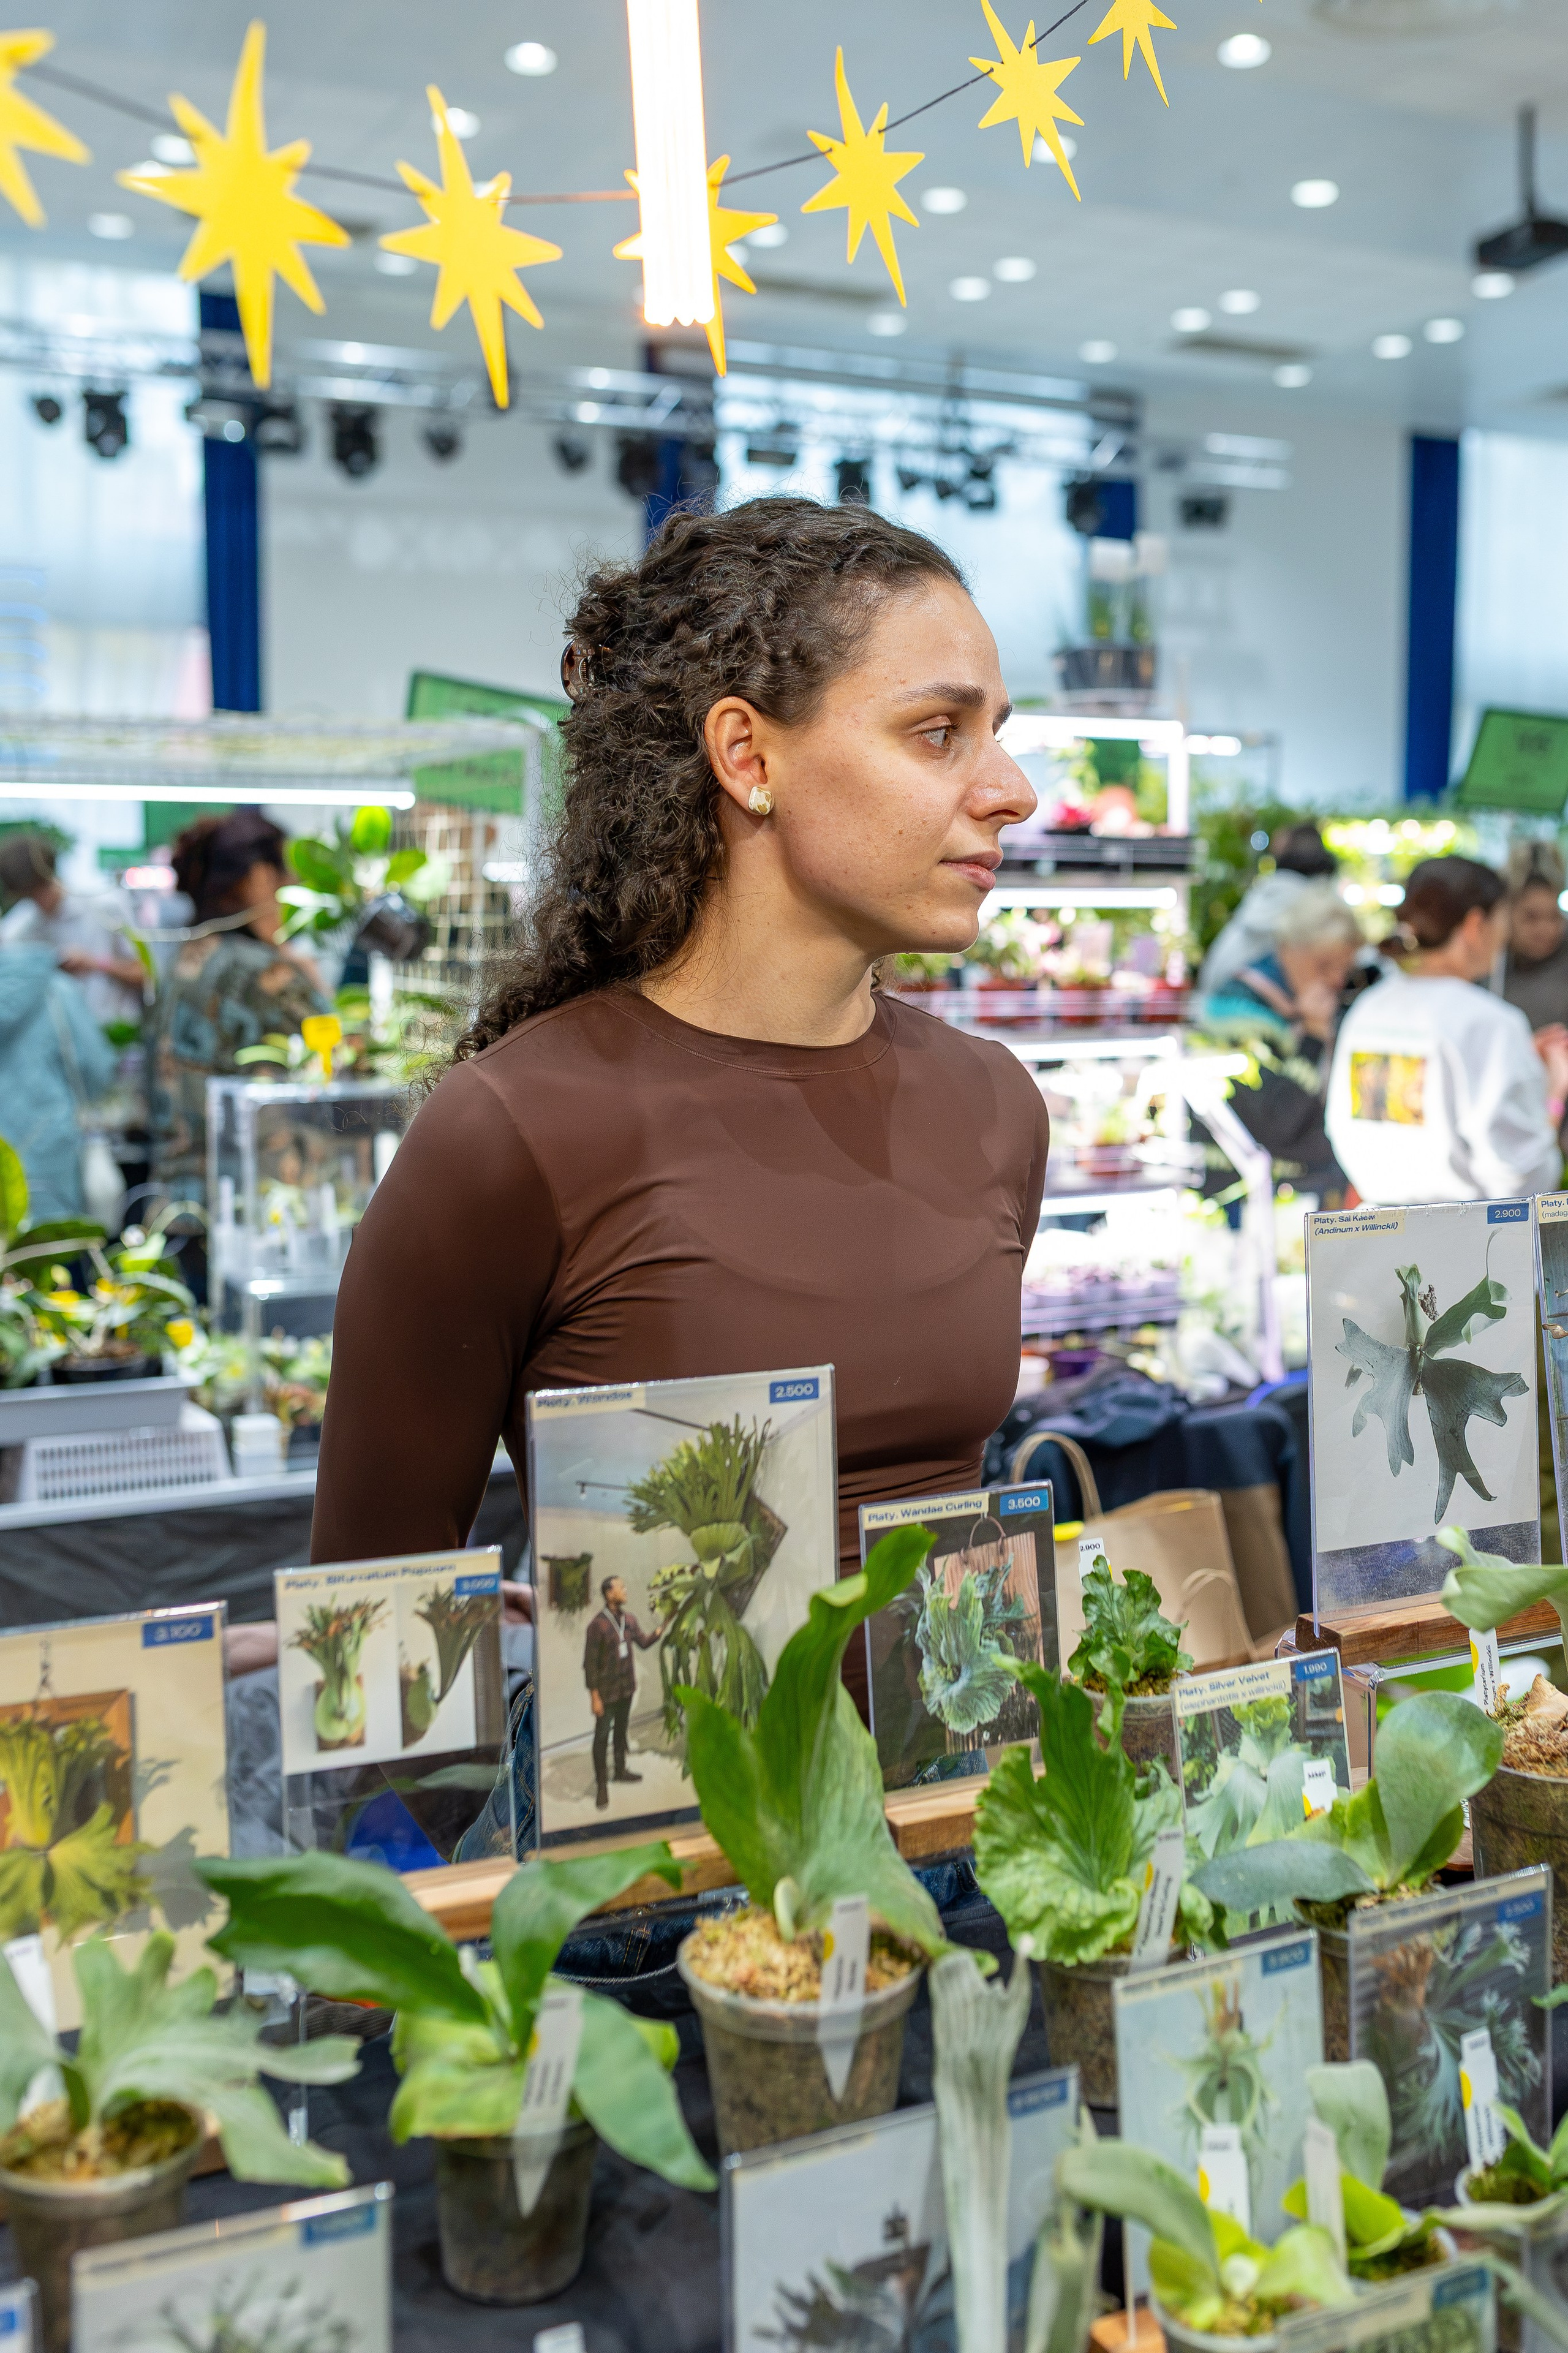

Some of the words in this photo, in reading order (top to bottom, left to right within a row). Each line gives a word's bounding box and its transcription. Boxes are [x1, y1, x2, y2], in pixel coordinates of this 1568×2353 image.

[1494, 1209, 1521, 1218] 2.900
[1314, 1217, 1336, 1225] Platy.
[1314, 1226, 1353, 1236] (Andinum
[1362, 1222, 1398, 1232] Willinckii)
[775, 1383, 814, 1398] 2.500
